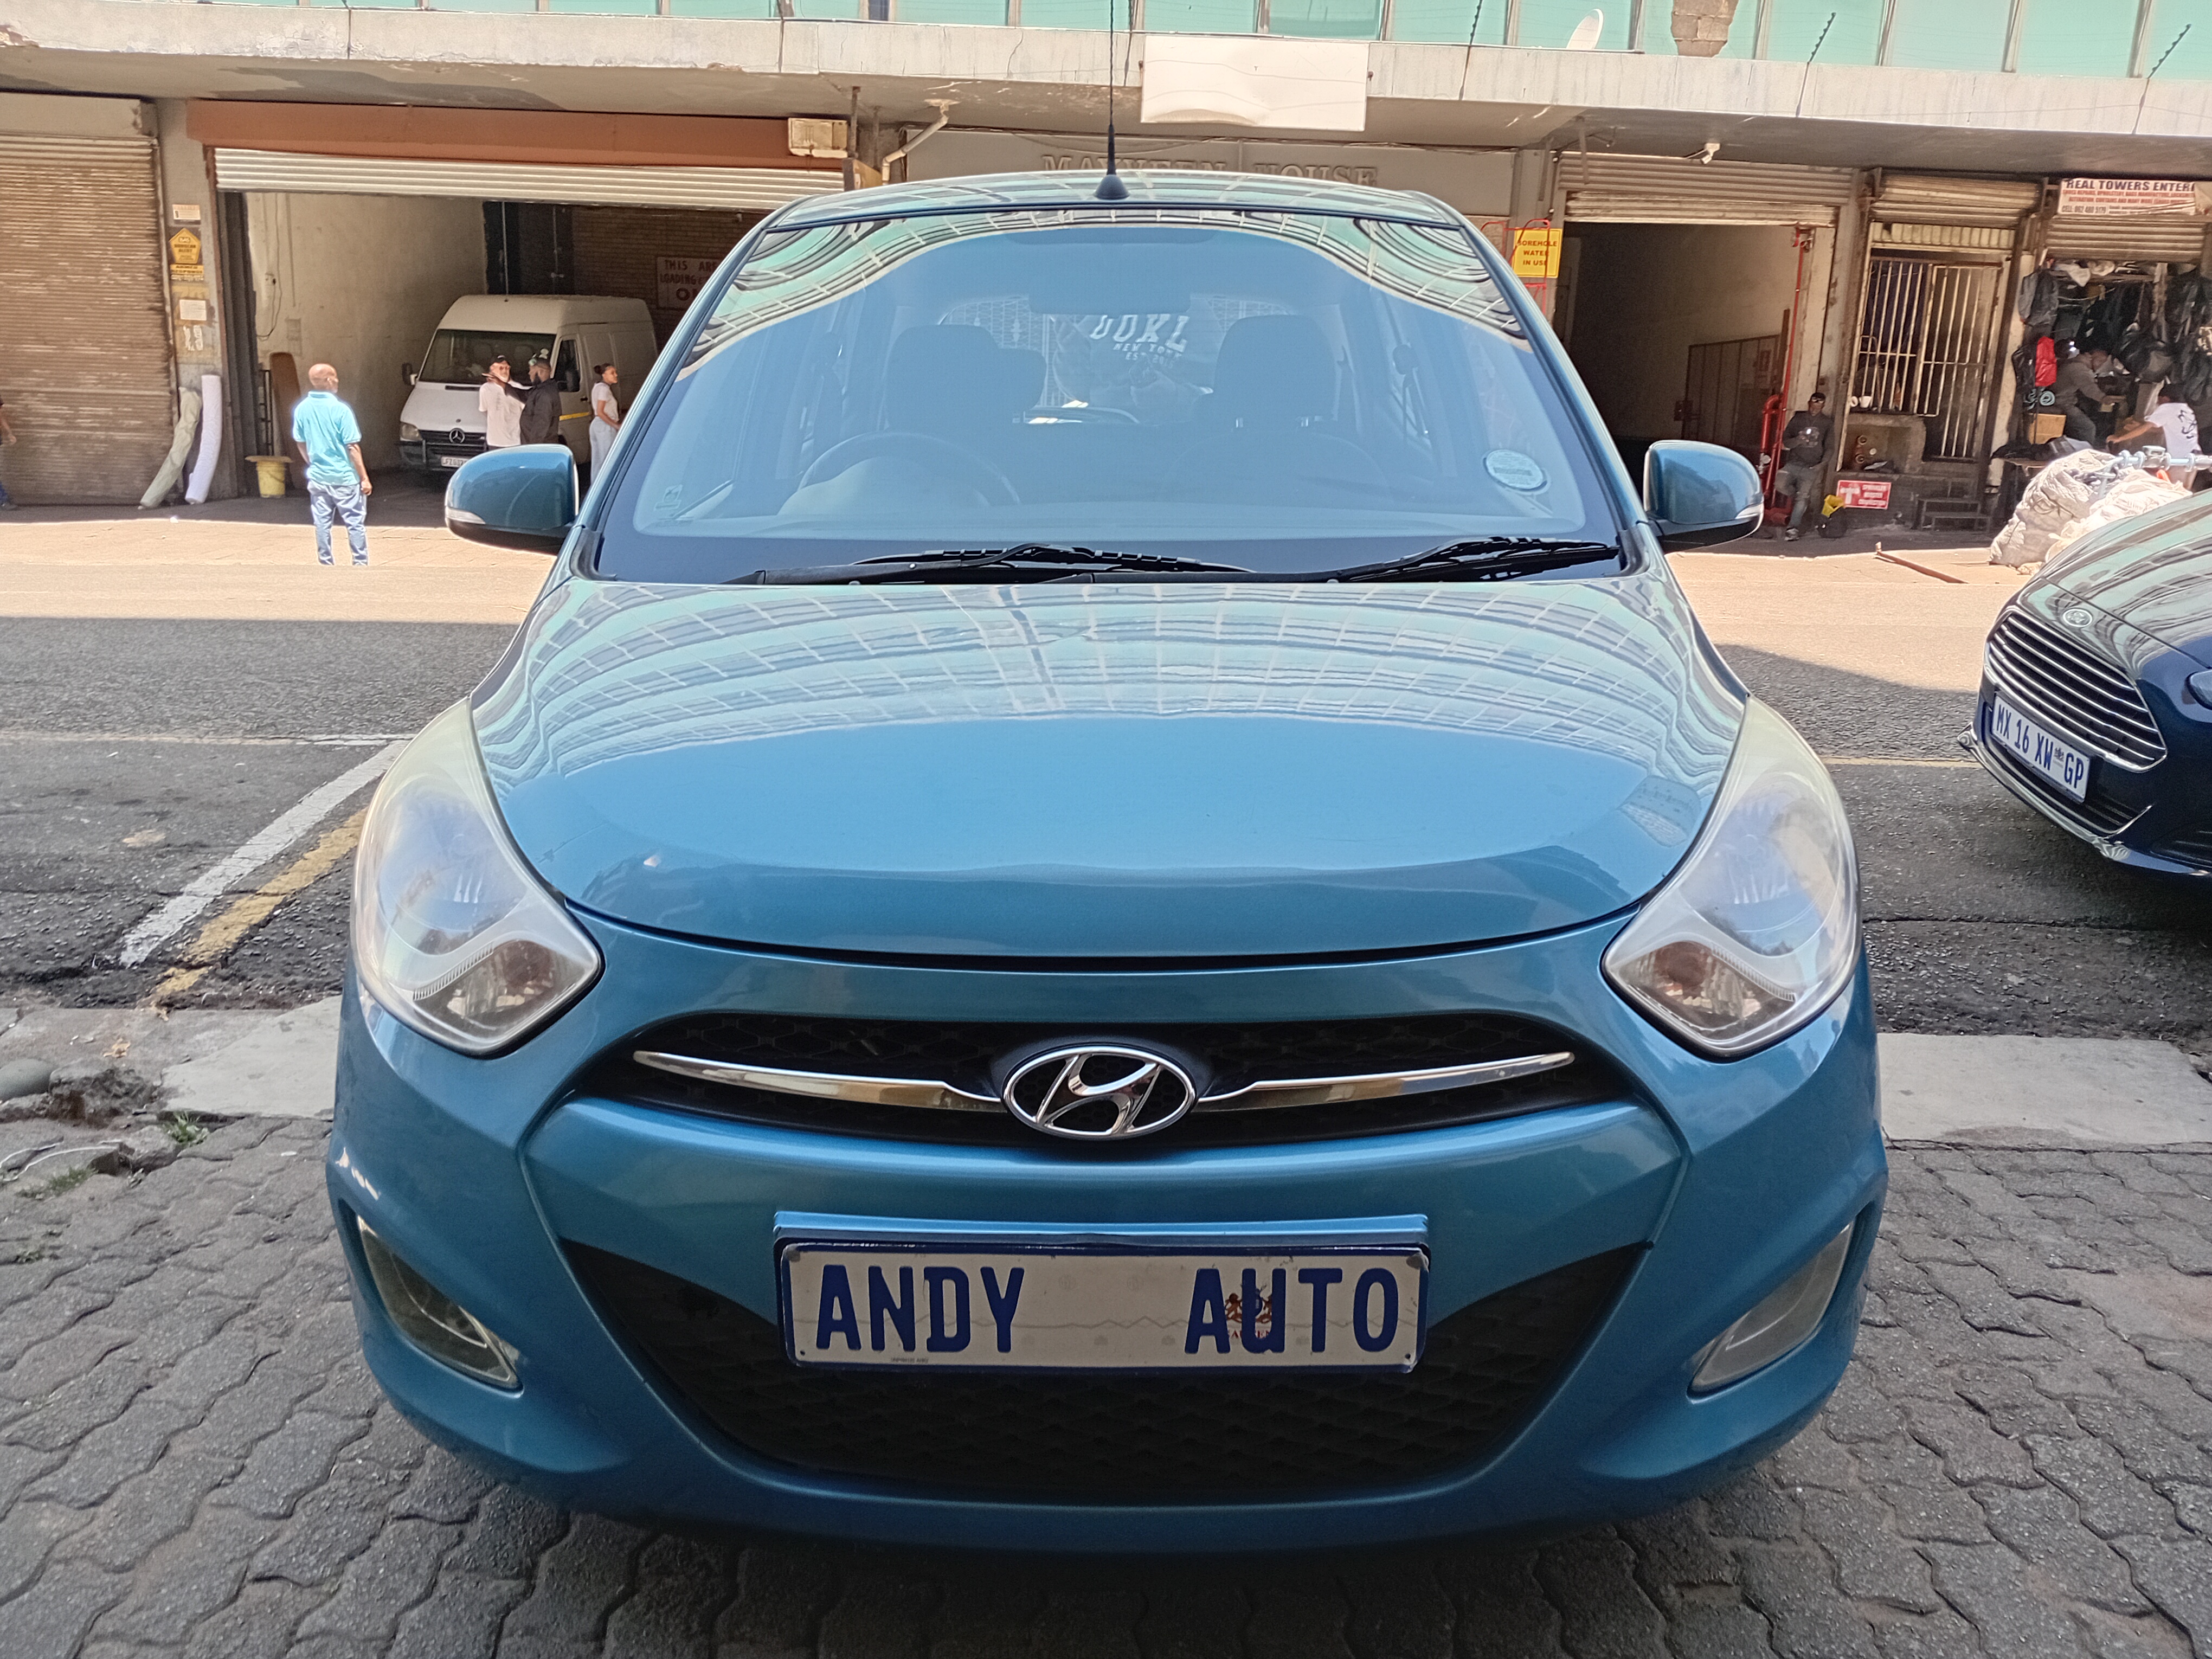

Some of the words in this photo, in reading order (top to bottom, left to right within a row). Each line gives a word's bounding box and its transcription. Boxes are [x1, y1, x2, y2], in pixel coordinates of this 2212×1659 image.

[2066, 180, 2095, 189] REAL
[2099, 181, 2150, 191] TOWERS
[2153, 182, 2195, 192] ENTER
[664, 260, 688, 271] THIS
[698, 261, 717, 271] ARE
[2014, 719, 2029, 754] 16
[2035, 732, 2054, 771] XW
[2063, 753, 2084, 789] GP
[816, 1264, 1025, 1353] ANDY
[1185, 1267, 1399, 1354] AUTO
